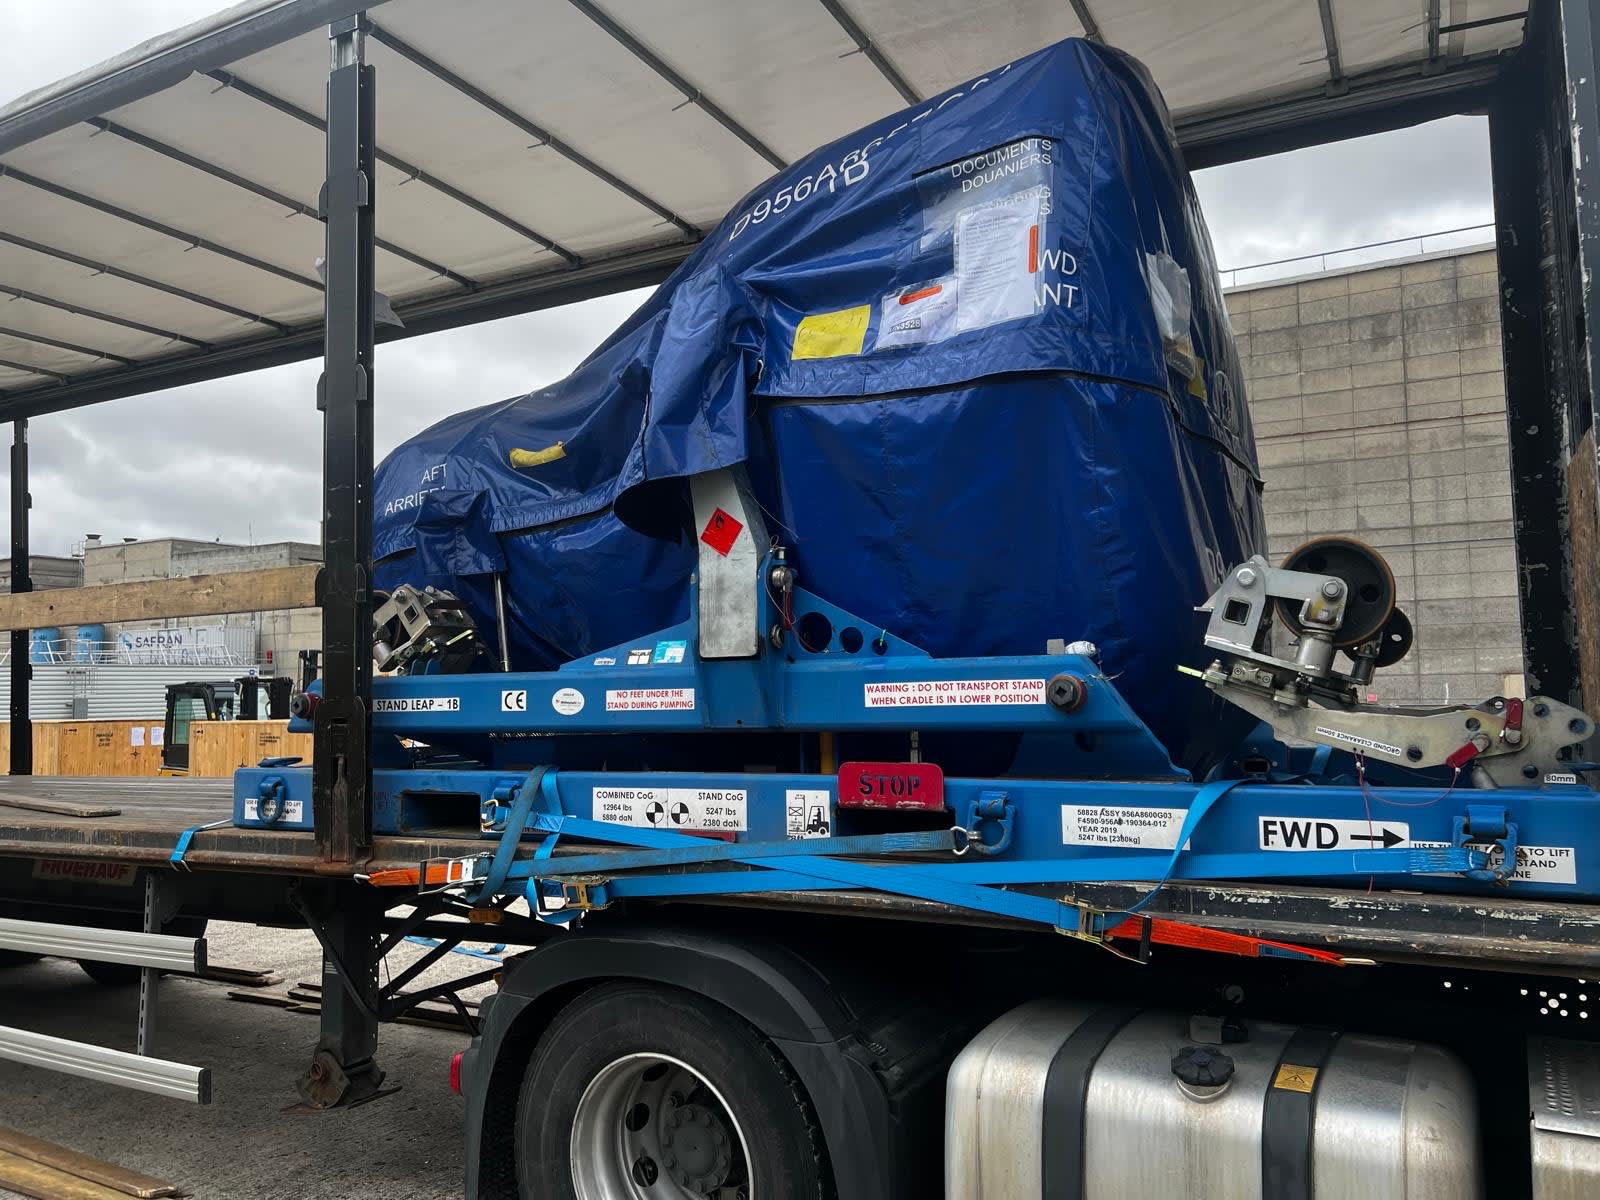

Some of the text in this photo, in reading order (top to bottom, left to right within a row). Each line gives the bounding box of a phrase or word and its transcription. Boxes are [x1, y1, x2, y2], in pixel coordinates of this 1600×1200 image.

[951, 139, 1052, 178] DOCUMENTS
[961, 153, 1052, 193] DOUANIERS
[421, 463, 447, 484] AFT
[866, 684, 909, 693] WARNING
[918, 684, 932, 692] DO
[935, 683, 954, 692] NOT
[956, 682, 1009, 691] TRANSPORT
[1012, 681, 1044, 690] STAND
[616, 691, 628, 699] NO
[646, 690, 669, 698] UNDER
[871, 693, 1039, 705] WHEN CRADLE IS IN LOWER POSITION
[377, 700, 408, 711] STAND
[412, 699, 435, 710] LEAP
[446, 698, 459, 709] 1B
[504, 691, 525, 710] CE
[631, 701, 657, 709] DURING
[660, 700, 693, 709] PUMPING
[1373, 743, 1400, 755] GROUND
[860, 773, 921, 796] STOP
[596, 791, 654, 800] COMBINED CoG
[698, 792, 744, 801] STAND CoG
[618, 813, 633, 821] daN
[705, 808, 737, 816] 5247 lbs
[1100, 809, 1120, 817] ASSY
[702, 819, 739, 828] 2380 daN
[1263, 820, 1339, 849] FWD
[1529, 849, 1545, 857] TO
[1550, 850, 1570, 858] LIFT
[1517, 859, 1557, 868] STAND
